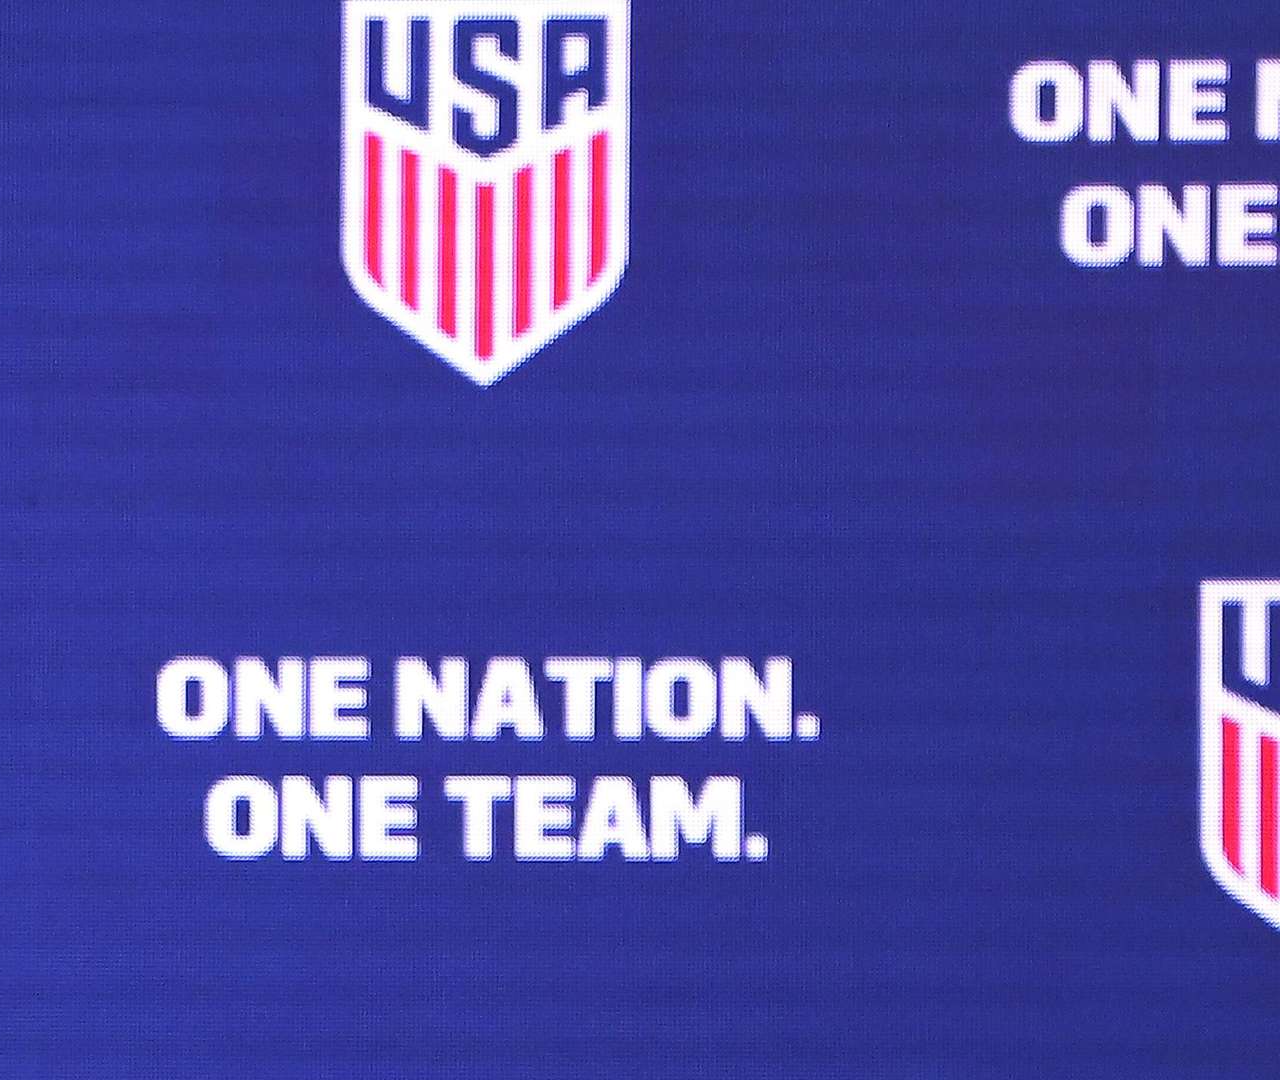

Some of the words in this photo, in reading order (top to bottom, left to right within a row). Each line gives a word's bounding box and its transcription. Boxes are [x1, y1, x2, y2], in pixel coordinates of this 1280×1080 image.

[365, 17, 608, 158] USA
[1009, 60, 1230, 143] ONE
[1060, 184, 1280, 268] ONE
[157, 656, 372, 741] ONE
[396, 656, 821, 742] NATION.
[205, 775, 419, 861] ONE
[444, 776, 769, 862] TEAM.
